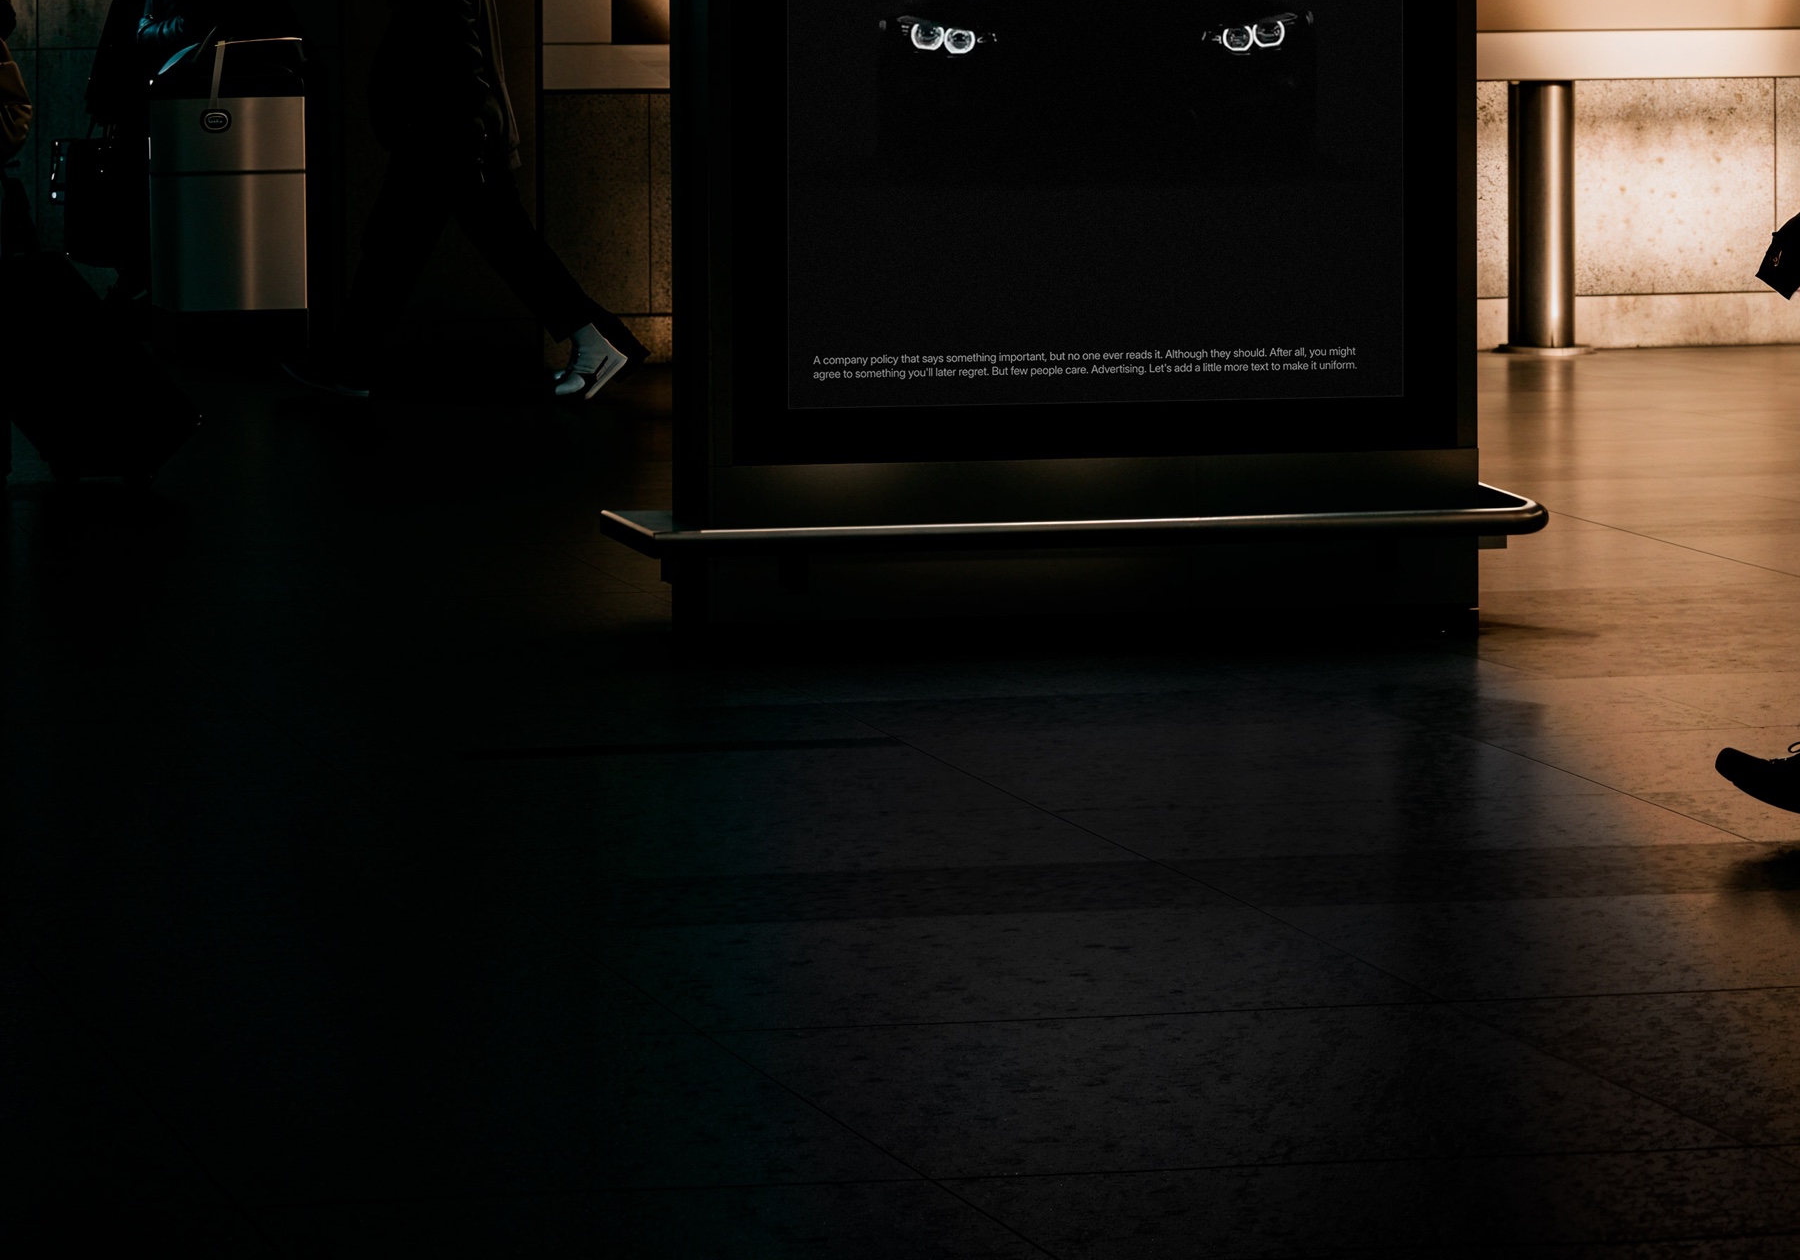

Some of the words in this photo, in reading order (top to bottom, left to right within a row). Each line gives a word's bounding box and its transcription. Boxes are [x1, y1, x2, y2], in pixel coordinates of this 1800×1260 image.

[812, 355, 822, 365] A
[822, 356, 869, 367] company
[870, 354, 899, 367] policy
[900, 353, 920, 364] that
[921, 355, 945, 366] says
[945, 352, 997, 365] something
[998, 352, 1048, 364] important,
[1049, 351, 1066, 361] but
[1067, 352, 1081, 361] no
[1081, 352, 1101, 361] one
[1102, 352, 1124, 361] ever
[1125, 349, 1153, 360] reads
[1154, 349, 1163, 359] it.
[1164, 348, 1209, 361] Although
[1209, 348, 1232, 361] they
[1232, 347, 1268, 358] should.
[1268, 346, 1293, 357] After
[1294, 346, 1307, 358] all,
[1308, 348, 1327, 359] you
[1328, 346, 1356, 359] might
[812, 370, 841, 382] agree
[842, 369, 854, 379] to
[854, 367, 906, 380] something
[907, 367, 934, 380] you'll
[935, 367, 957, 377] later
[958, 367, 990, 379] regret.
[991, 365, 1009, 376] But
[1010, 365, 1029, 376] few
[1030, 365, 1064, 378] people
[1064, 366, 1089, 375] care.
[1090, 363, 1147, 376] Advertising.
[1148, 363, 1173, 373] Let's
[1173, 362, 1193, 373] add
[1194, 364, 1201, 373] a
[1202, 362, 1223, 372] little
[1223, 363, 1249, 372] more
[1250, 362, 1270, 372] text
[1270, 362, 1281, 371] to
[1282, 360, 1310, 371] make
[1310, 360, 1317, 370] it
[1319, 359, 1358, 370] uniform.
